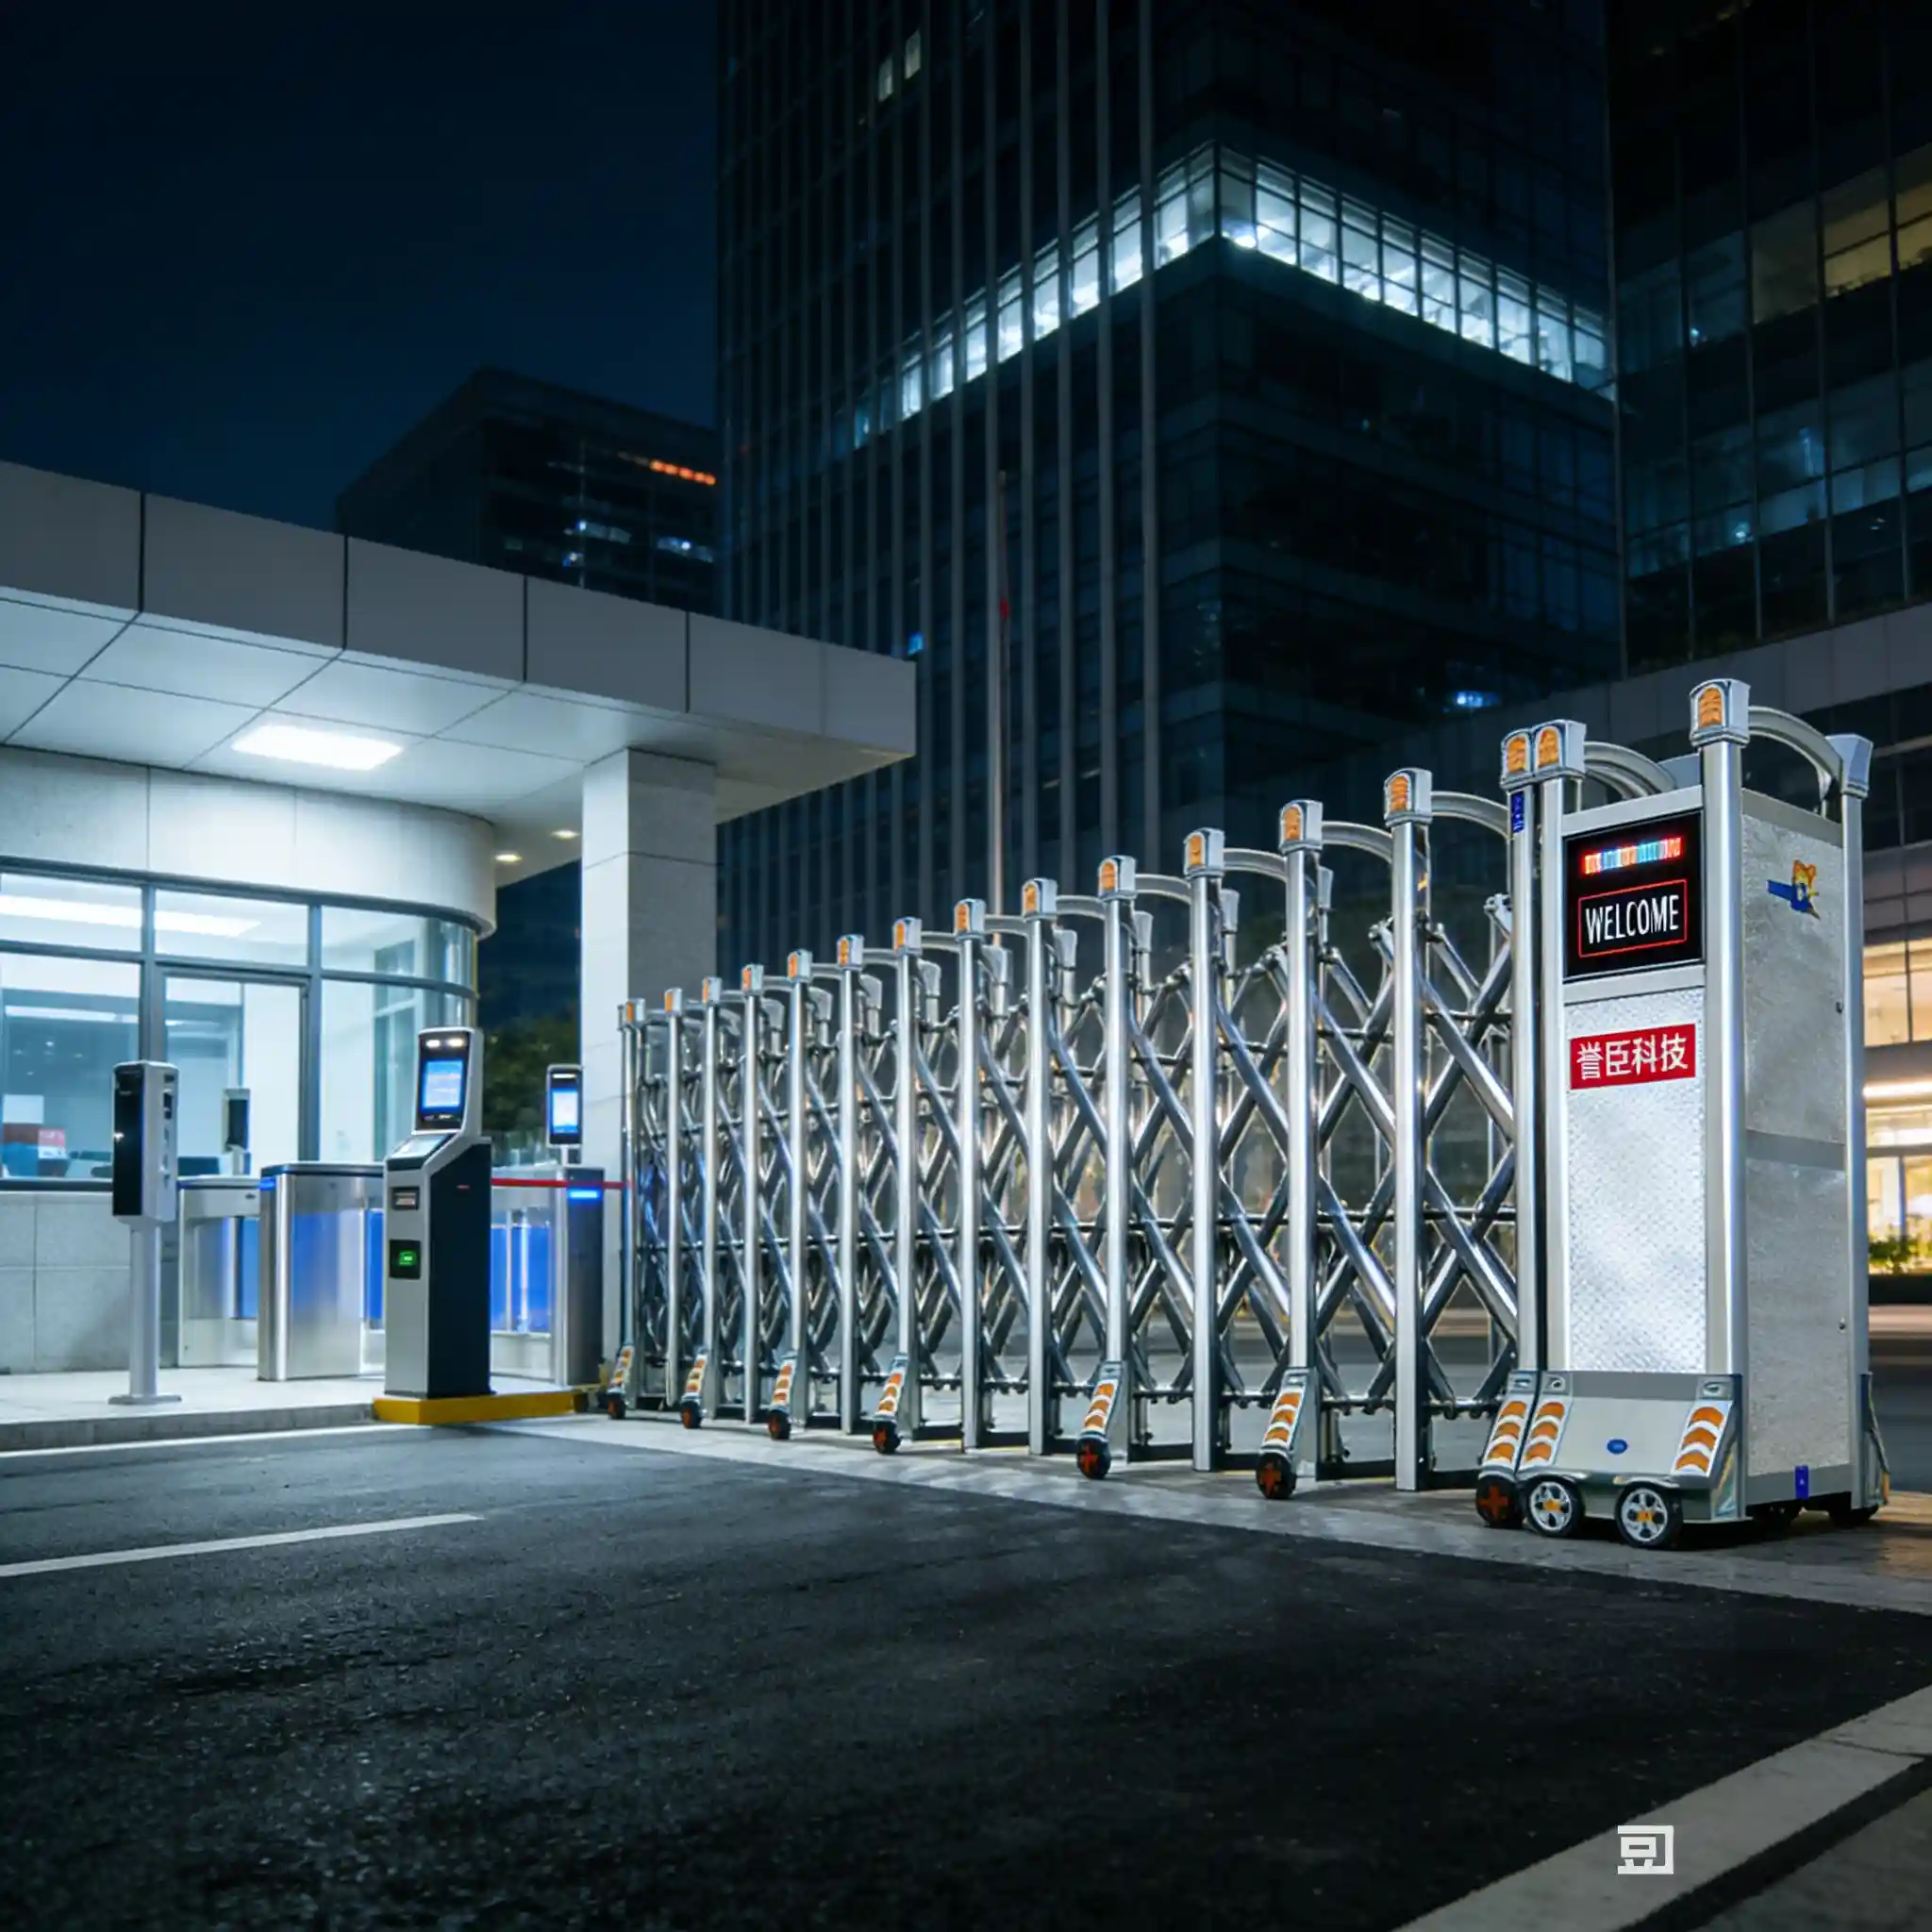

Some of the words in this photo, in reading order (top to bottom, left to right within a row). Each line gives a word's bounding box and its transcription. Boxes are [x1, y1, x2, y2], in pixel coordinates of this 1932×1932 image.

[1586, 894, 1679, 944] WELCOME
[1576, 1032, 1689, 1080] 誉臣科技
